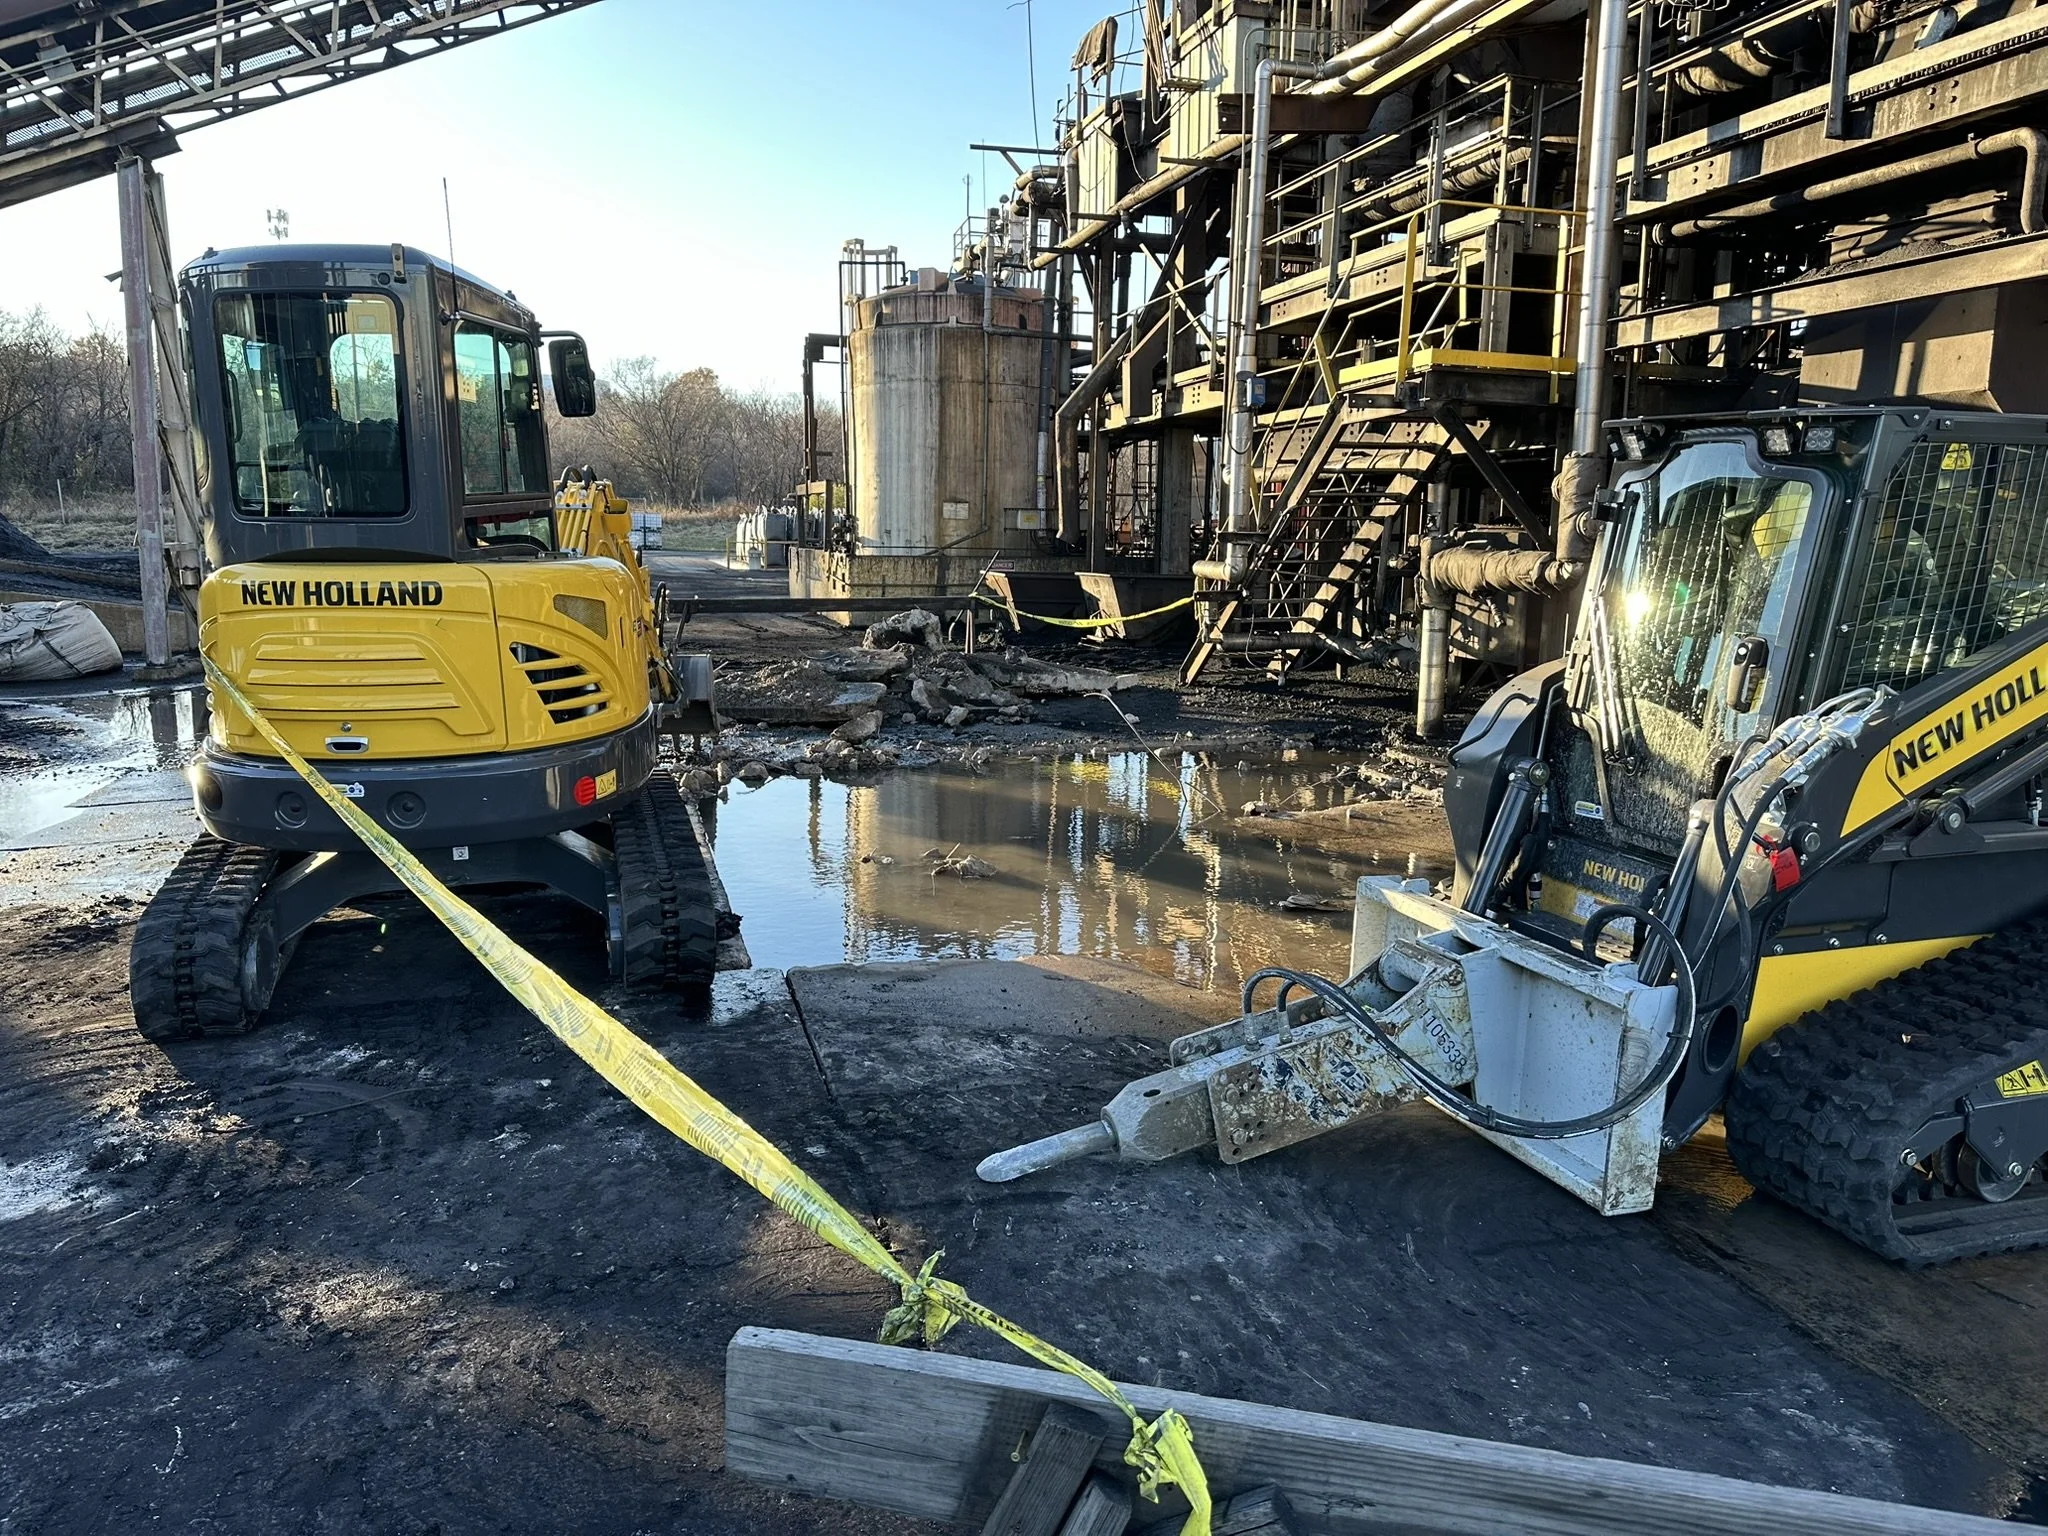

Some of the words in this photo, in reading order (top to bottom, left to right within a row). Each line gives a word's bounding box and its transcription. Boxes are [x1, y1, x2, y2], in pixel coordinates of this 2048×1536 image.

[241, 580, 296, 606] NEW
[303, 581, 443, 607] HOLLAND
[1893, 710, 1964, 778] NEW
[1583, 859, 1616, 882] NEW
